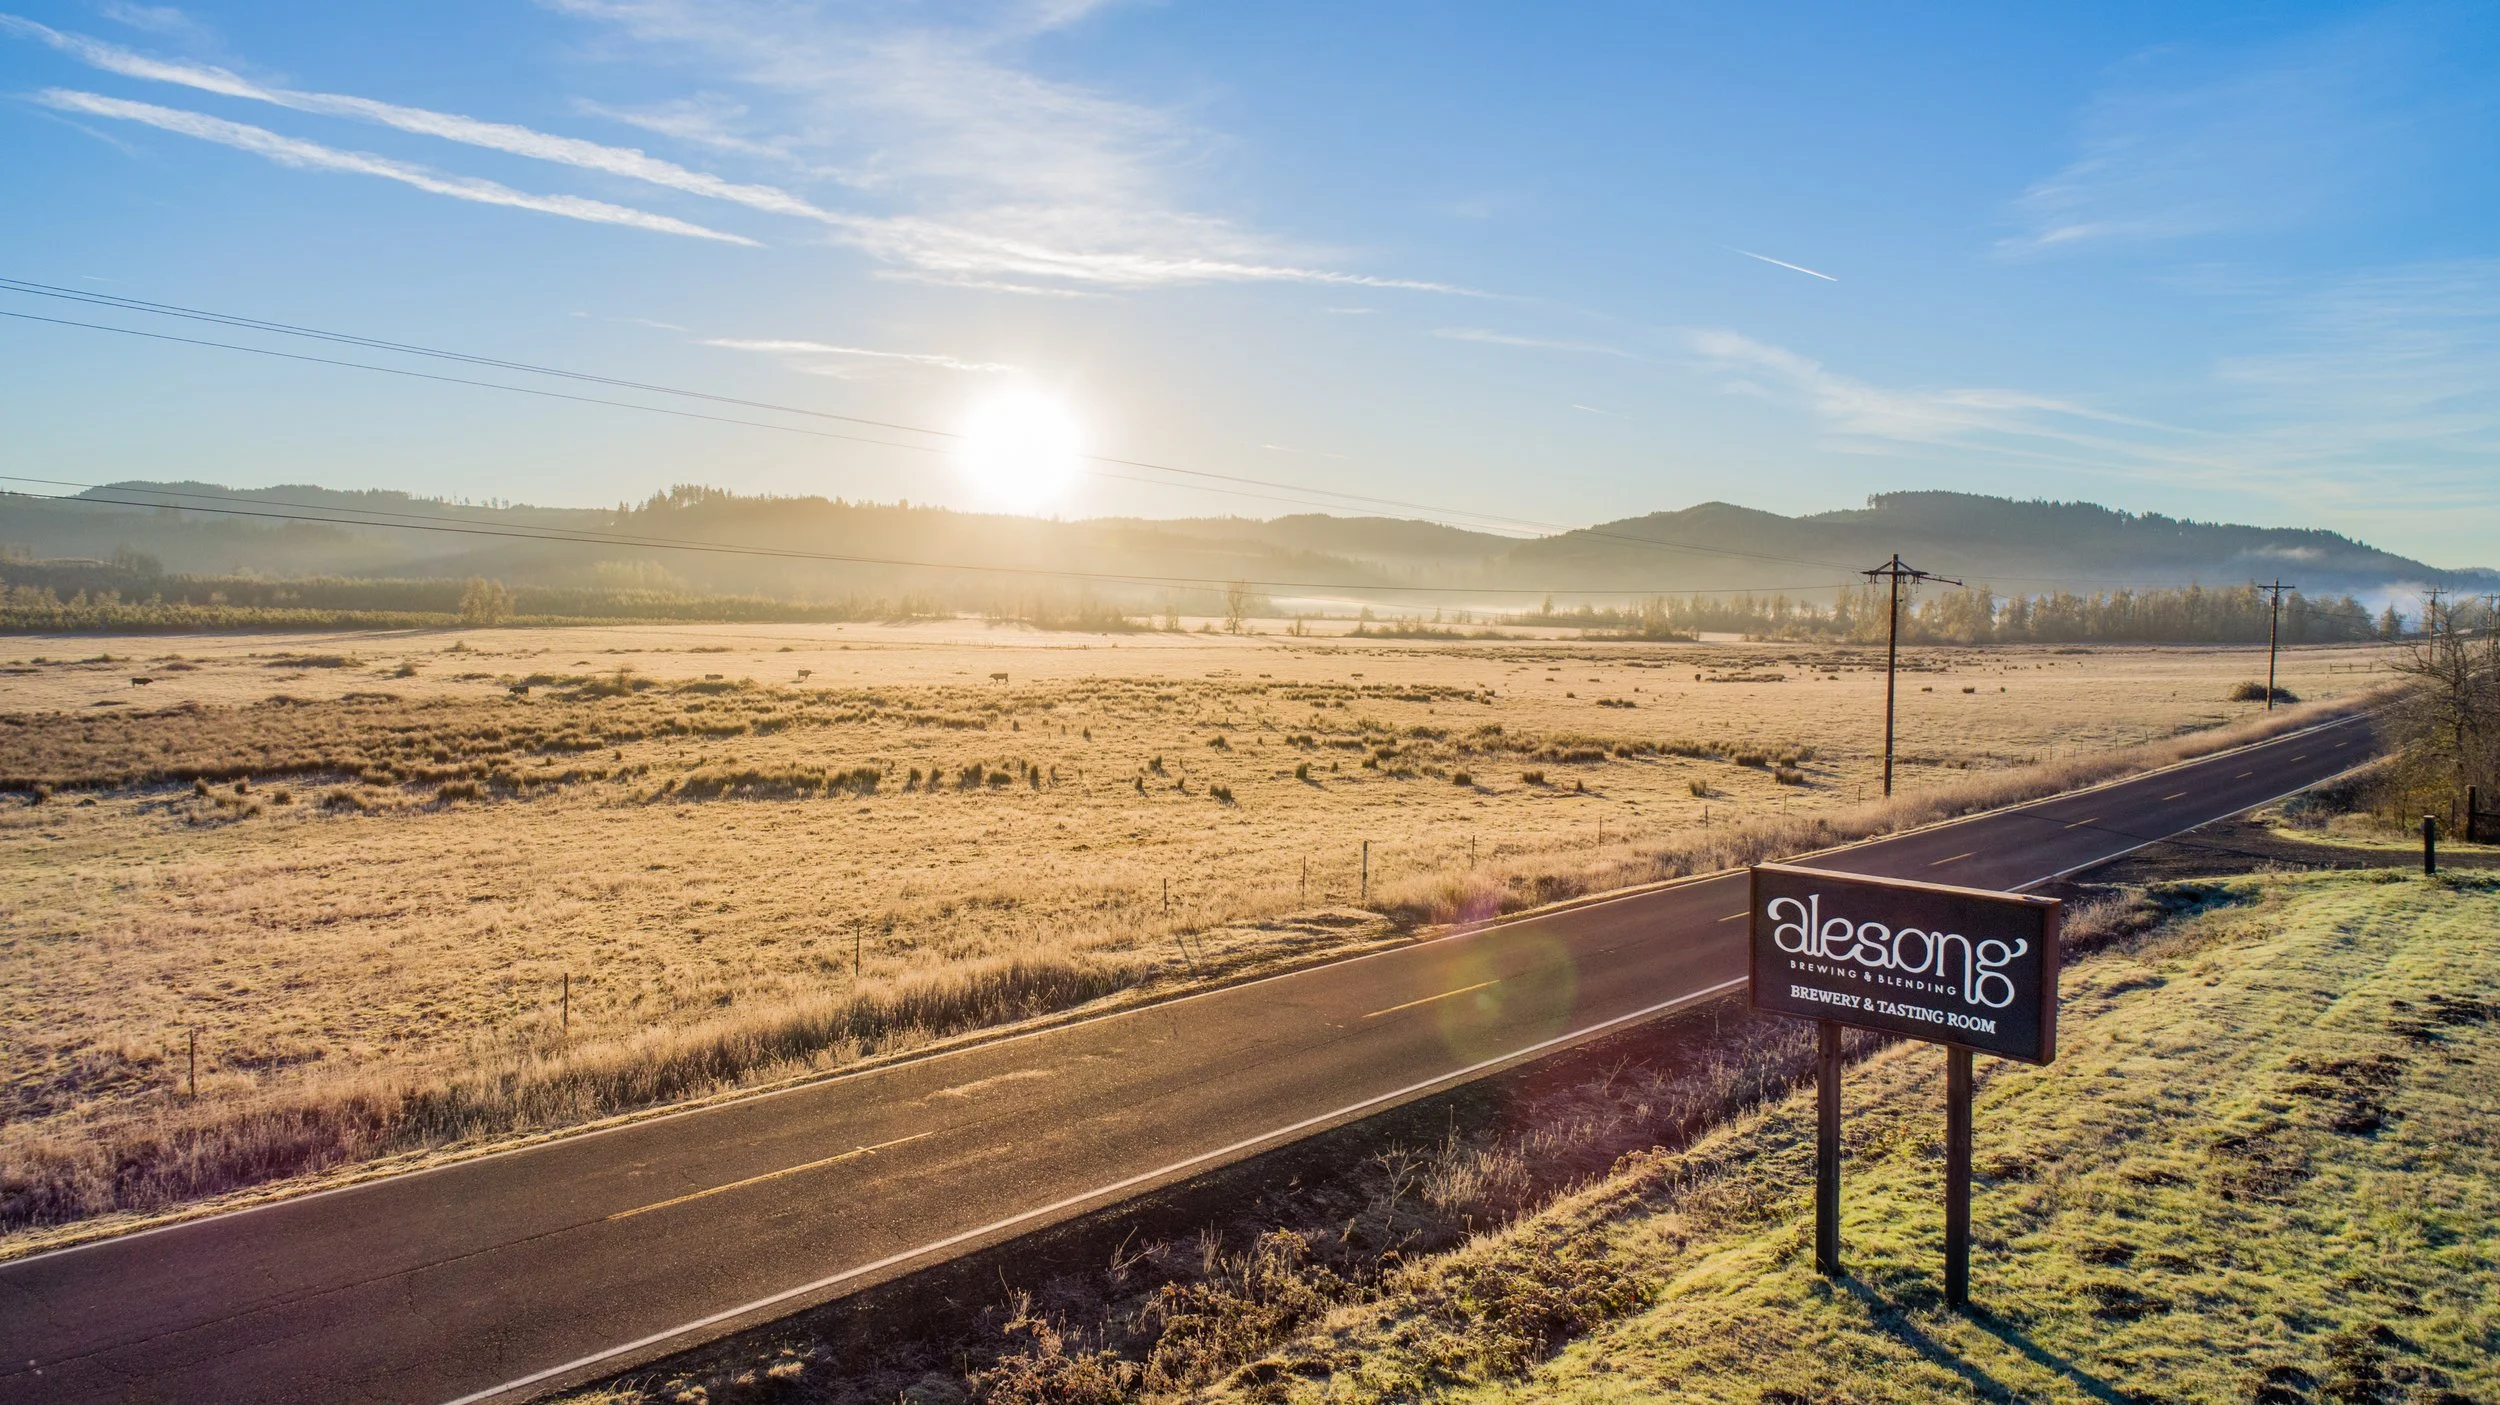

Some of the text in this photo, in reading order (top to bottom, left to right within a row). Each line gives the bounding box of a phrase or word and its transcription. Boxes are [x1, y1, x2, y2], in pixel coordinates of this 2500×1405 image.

[1767, 893, 2028, 1008] alesong
[1790, 960, 1957, 996] BREWING & BLENDING
[1790, 984, 1996, 1034] BREWERY & TASTING ROOM
